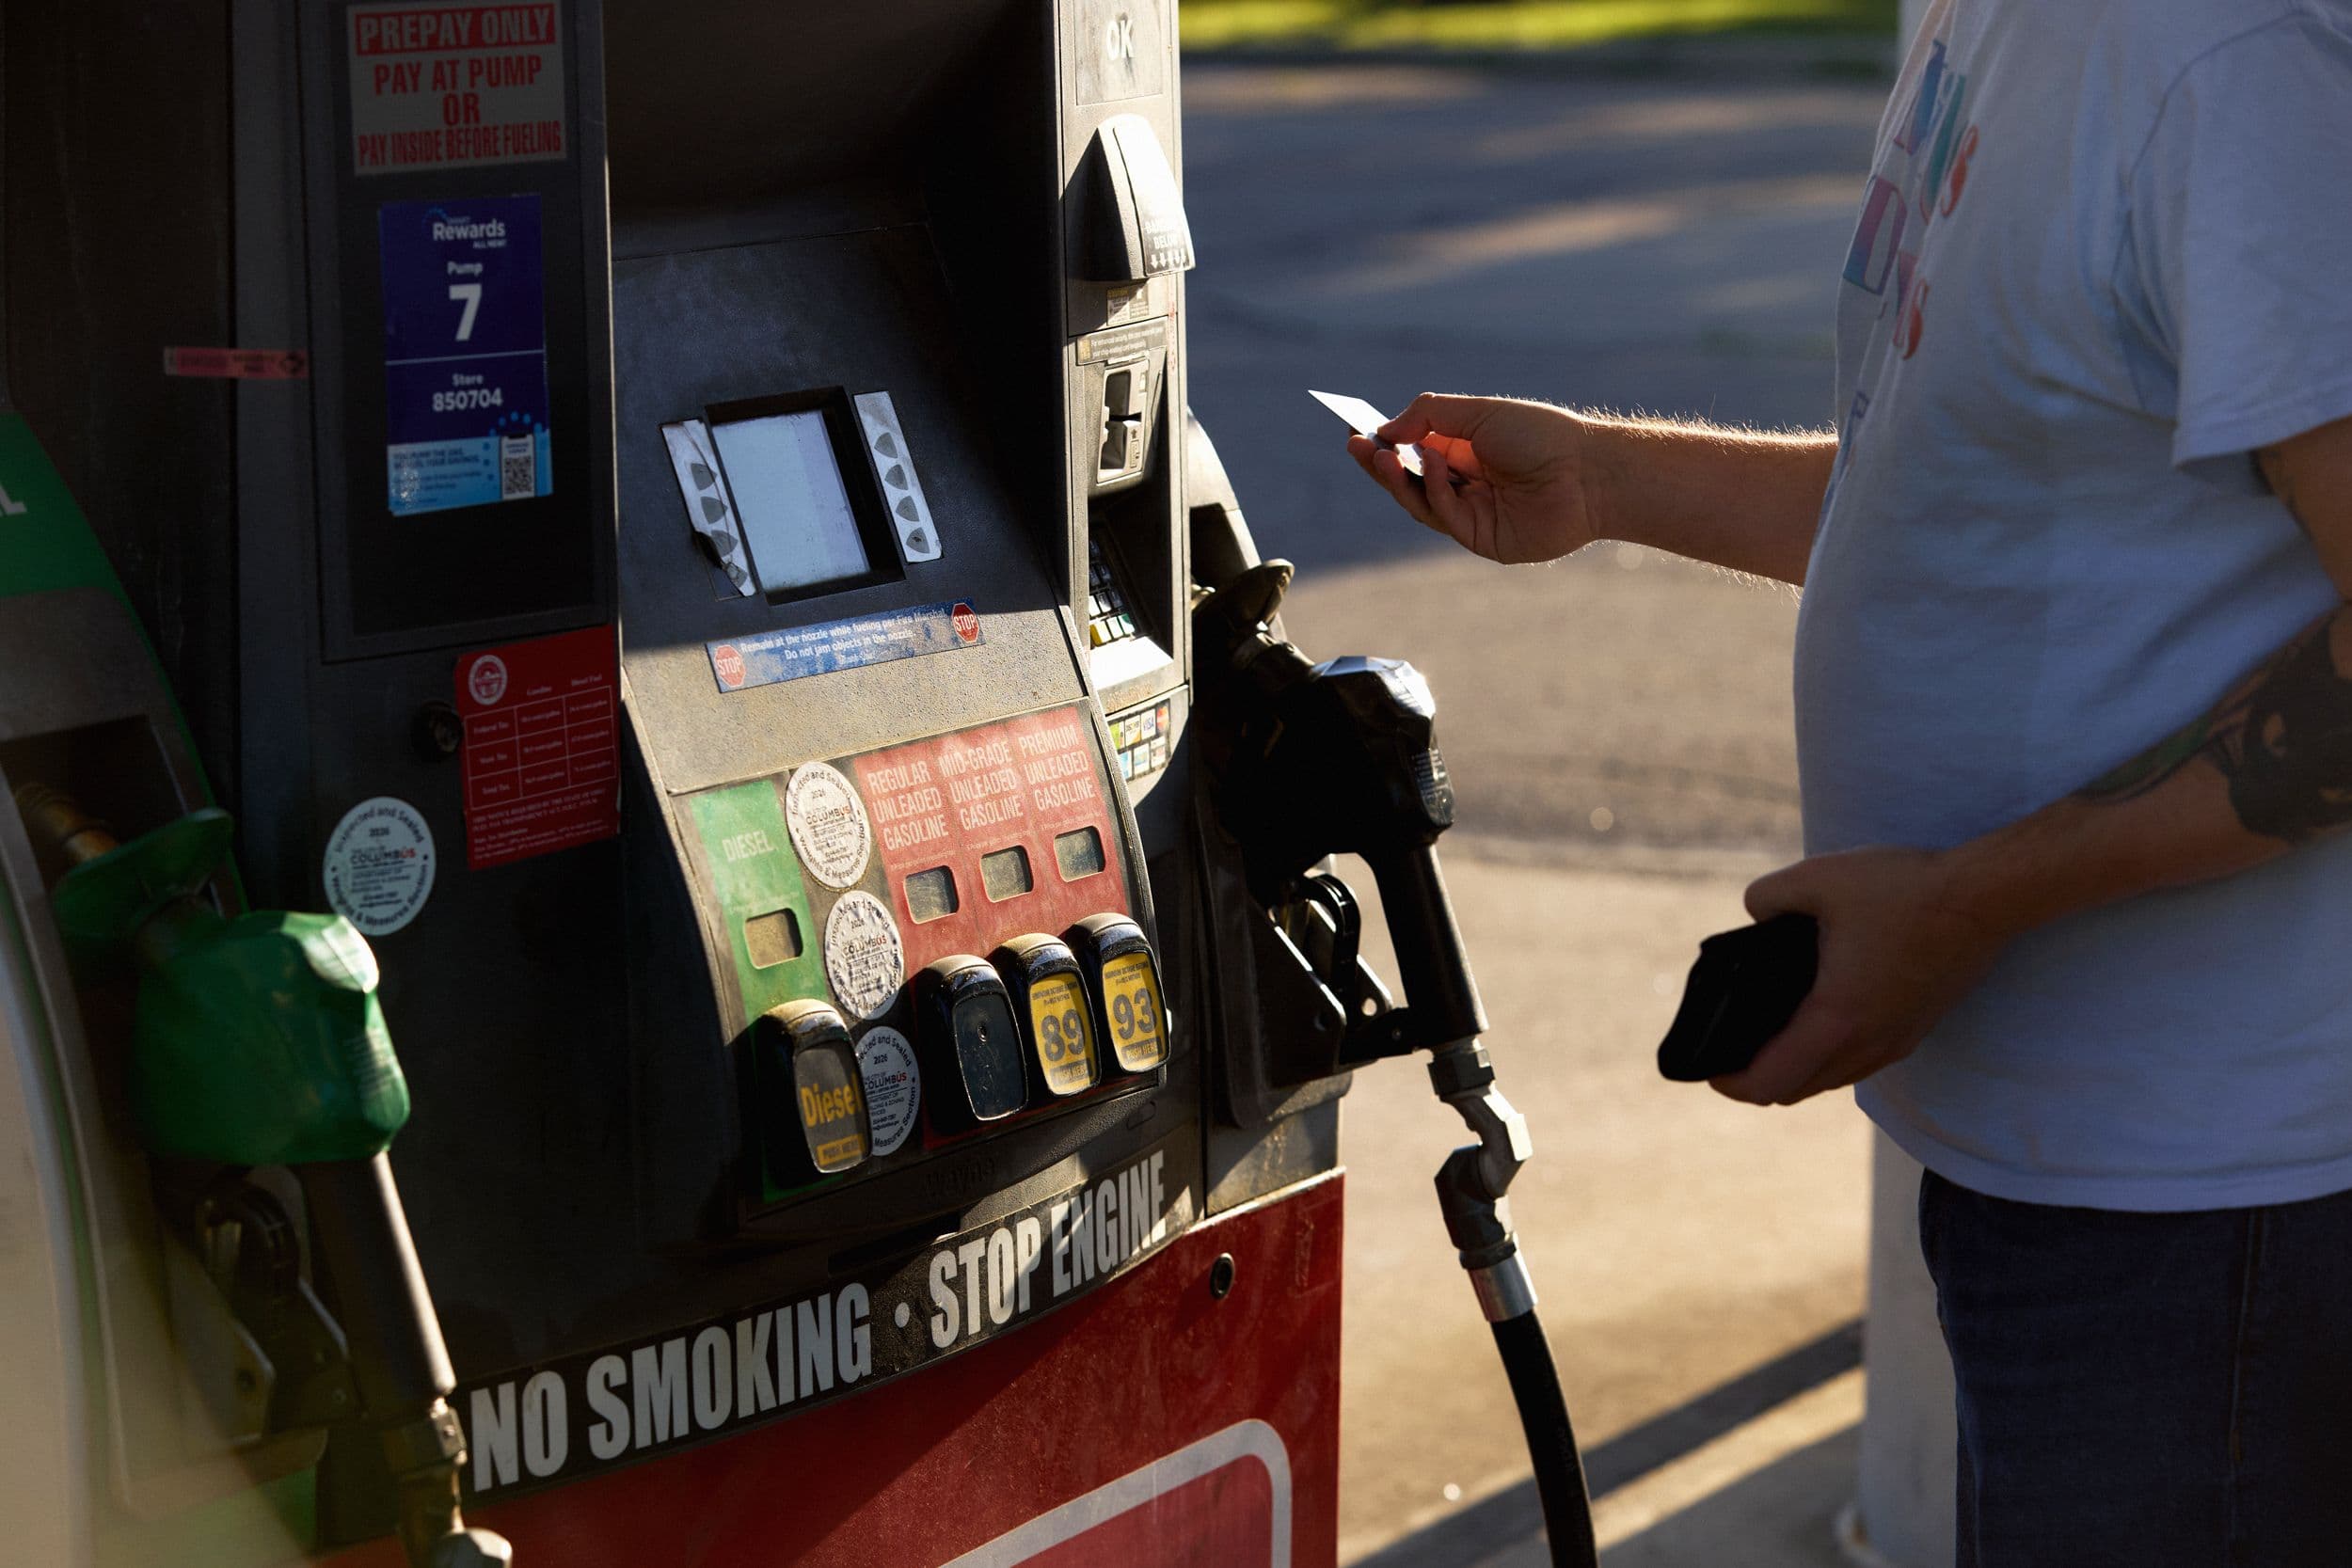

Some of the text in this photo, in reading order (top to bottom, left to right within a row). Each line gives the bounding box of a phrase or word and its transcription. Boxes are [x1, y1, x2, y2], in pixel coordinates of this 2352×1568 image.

[359, 8, 549, 51] PREPAY ONLY
[1106, 21, 1136, 60] OK
[373, 55, 543, 96] PAY AT PUMP
[442, 93, 481, 125] OR
[358, 120, 562, 166] PAY INSIDE BEFORE FUELING
[432, 218, 506, 242] Rewards
[446, 260, 485, 277] Pump
[449, 284, 482, 341] 7
[453, 373, 484, 387] Store
[433, 388, 502, 412] 850704
[740, 640, 773, 654] Remain
[775, 637, 784, 647] at
[786, 634, 800, 646] the
[802, 629, 829, 643] nozzle
[830, 625, 850, 640] while
[852, 620, 881, 636] fueling
[954, 615, 977, 633] STOP
[785, 649, 798, 660] Do
[799, 646, 813, 657] not
[814, 643, 832, 657] jam
[834, 639, 862, 654] objects
[863, 637, 872, 647] in
[873, 634, 886, 645] the
[717, 657, 742, 676] STOP
[1018, 724, 1079, 757] PREMIUM
[811, 771, 825, 781] and
[939, 740, 1012, 778] MID-GRADE
[1024, 751, 1089, 785] UNLEADED
[867, 760, 931, 795] REGULAR
[949, 768, 1017, 804] UNLEADED
[1034, 776, 1096, 812] GASOLINE
[806, 805, 851, 826] COLUMBUS
[873, 787, 941, 824] UNLEADED
[960, 795, 1024, 831] GASOLINE
[722, 830, 777, 863] DIESEL
[882, 815, 948, 851] GASOLINE
[350, 847, 416, 864] COLUMBUS
[843, 934, 887, 957] COLUMBUS
[1112, 989, 1157, 1040] 93
[877, 1035, 891, 1045] and
[891, 1038, 912, 1068] Sealed
[1041, 1008, 1086, 1062] 89
[902, 1086, 915, 1126] Section
[928, 1151, 1168, 1350] STOP ENGINE
[470, 1280, 872, 1494] NO SMOKING
